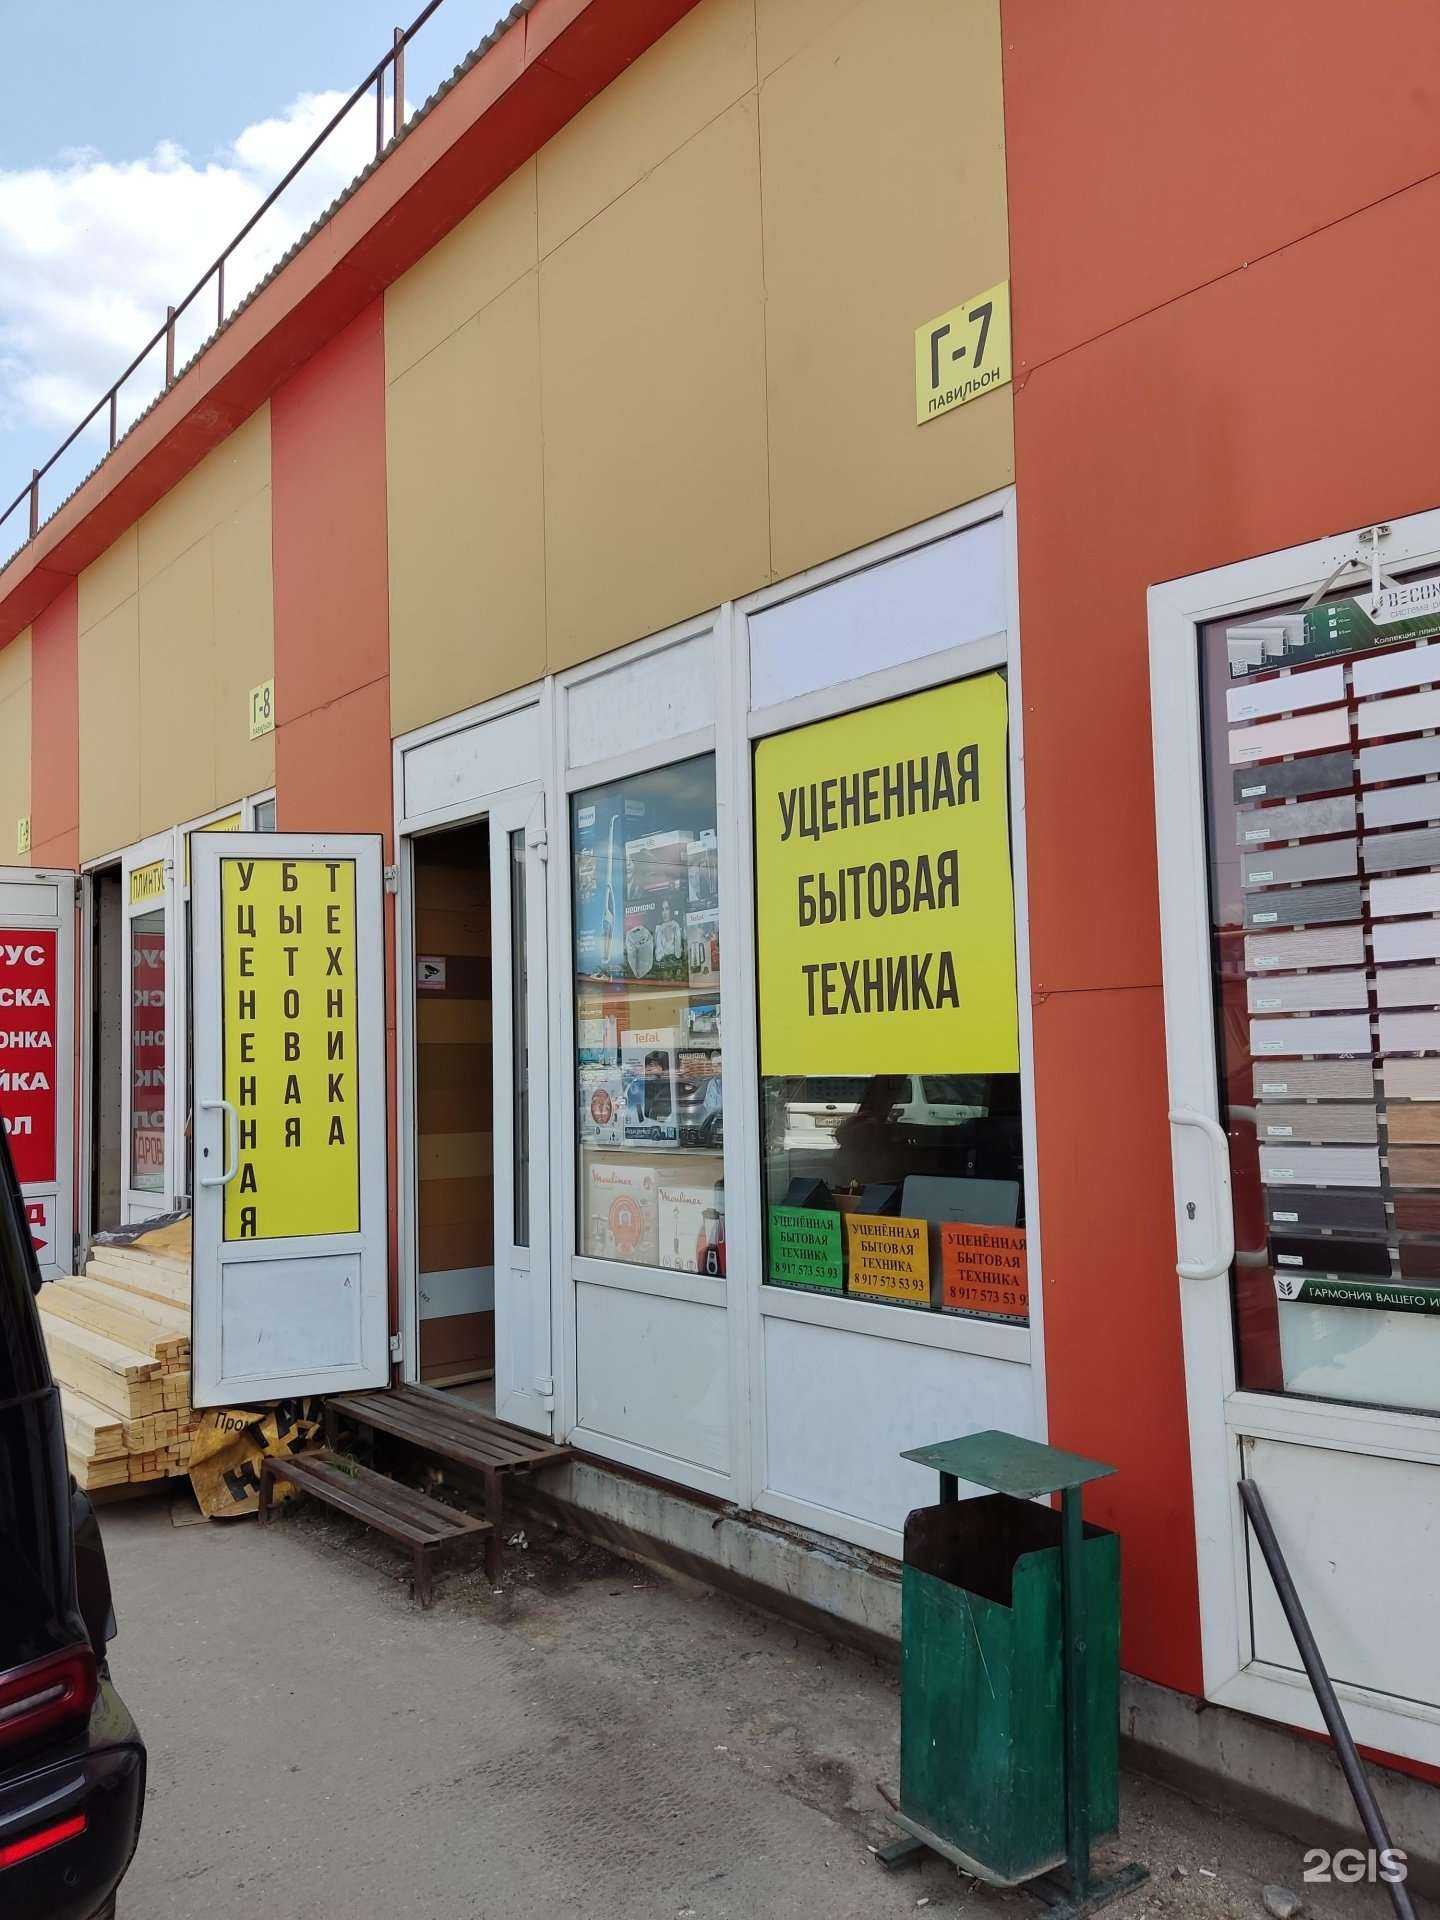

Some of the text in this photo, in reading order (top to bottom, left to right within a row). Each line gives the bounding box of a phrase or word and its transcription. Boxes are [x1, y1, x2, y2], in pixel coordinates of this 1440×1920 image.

[930, 301, 993, 389] Г-7
[928, 367, 1001, 413] ПАВИЛЬОН
[253, 687, 271, 724] Г-8
[778, 743, 981, 842] УЦЕНЕННАЯ
[798, 850, 960, 927] БЫТОВАЯ
[802, 951, 960, 1017] ТЕХНИКА
[279, 863, 302, 1148] БЫТОВАЯ
[325, 863, 346, 1146] ТЕХНИКА
[236, 863, 257, 1238] УЦЕНЕННАЯ
[773, 1215, 834, 1231] УЦЕНЁННАЯ
[851, 1223, 920, 1239] УЦЕНЁННАЯ
[780, 1231, 829, 1246] БЫТОВАЯ
[781, 1247, 829, 1262] ТЕХНИКА
[861, 1241, 914, 1256] БЫТОВАЯ
[862, 1257, 913, 1273] ТЕХНИКА
[957, 1251, 1021, 1269] БЫТОВАЯ
[782, 1264, 797, 1275] 917
[798, 1265, 814, 1276] 573
[815, 1267, 826, 1277] 53
[827, 1268, 838, 1279] 93
[958, 1269, 1020, 1287] ТЕХНИКА
[862, 1275, 877, 1287] 917
[880, 1277, 897, 1289] 573
[899, 1278, 911, 1290] 53
[912, 1280, 925, 1292] 93
[957, 1288, 978, 1300] 917
[979, 1290, 1001, 1303] 573
[1003, 1293, 1017, 1305] 53
[1309, 1287, 1440, 1307] ГАРМОНИЯ ВАШЕГО И
